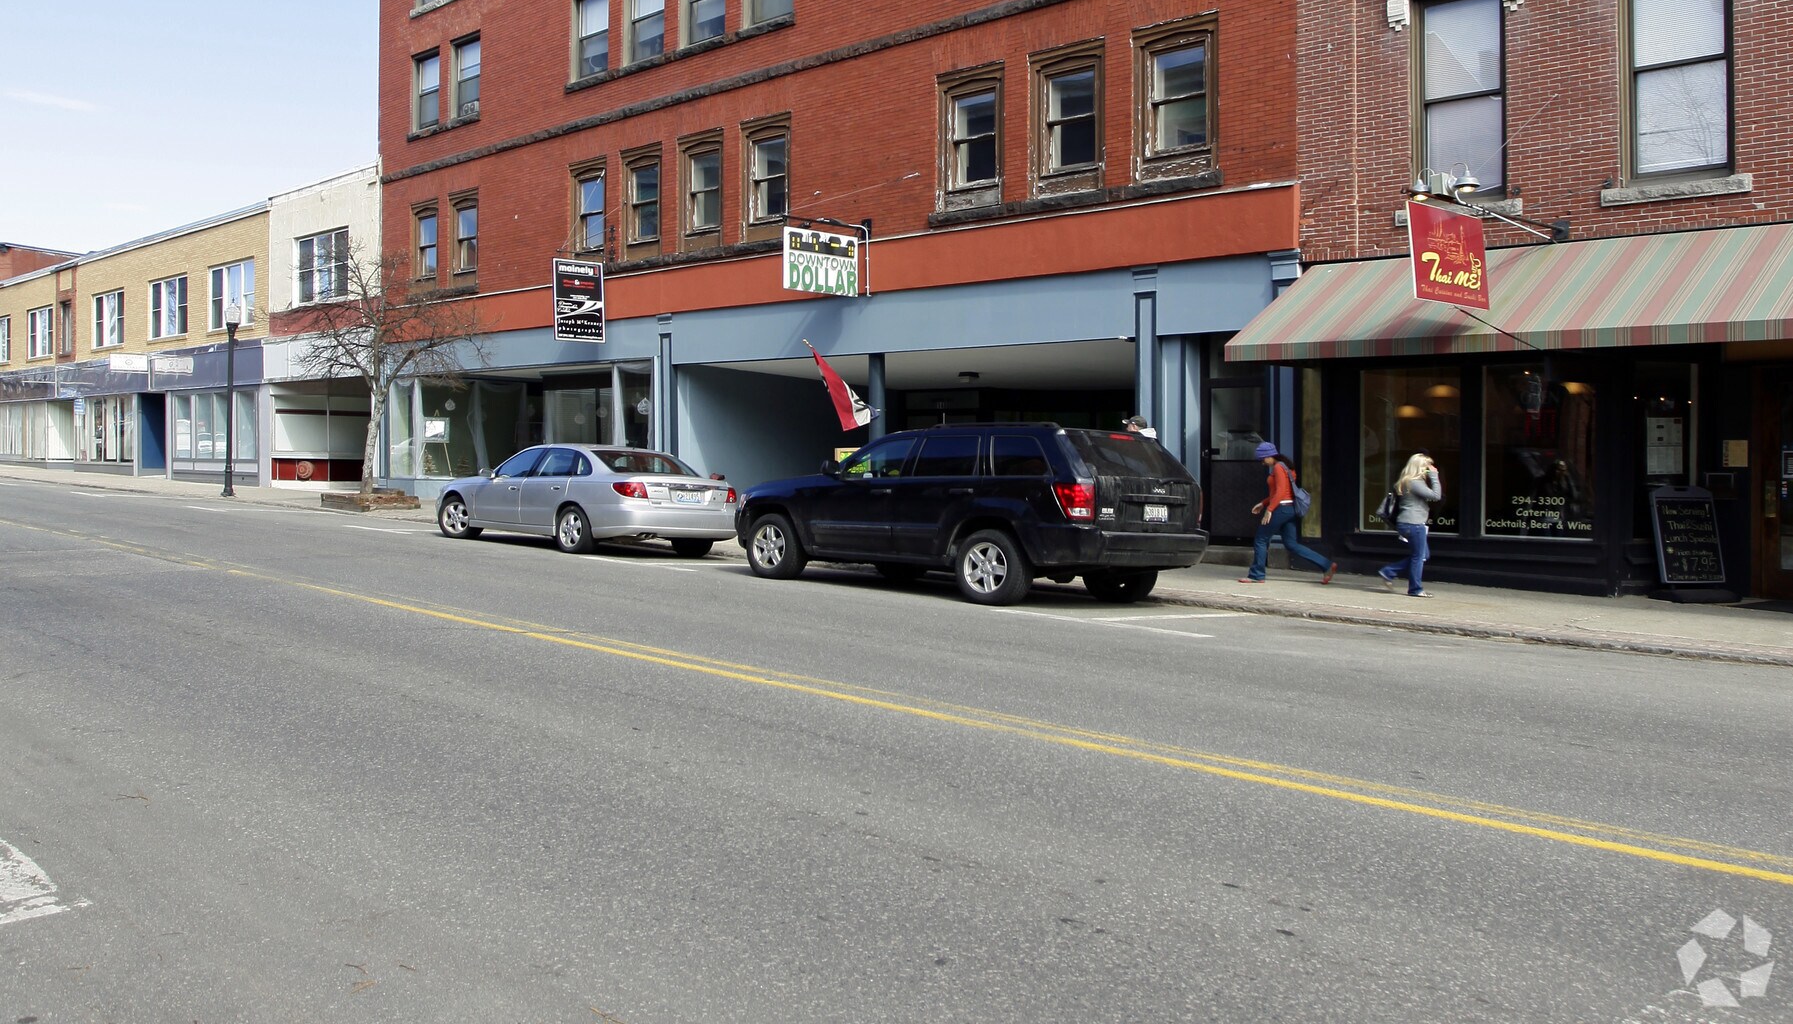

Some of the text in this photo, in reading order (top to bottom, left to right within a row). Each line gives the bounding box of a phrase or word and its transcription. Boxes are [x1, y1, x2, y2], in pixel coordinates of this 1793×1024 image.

[789, 252, 856, 271] DOWNTOWN
[1421, 252, 1453, 283] Thai
[788, 263, 858, 296] DOLLAR
[1511, 496, 1565, 506] 294-3300
[1516, 508, 1560, 519] Catering
[1437, 517, 1456, 526] Out
[1556, 521, 1564, 529] &
[1567, 521, 1592, 530] Wine
